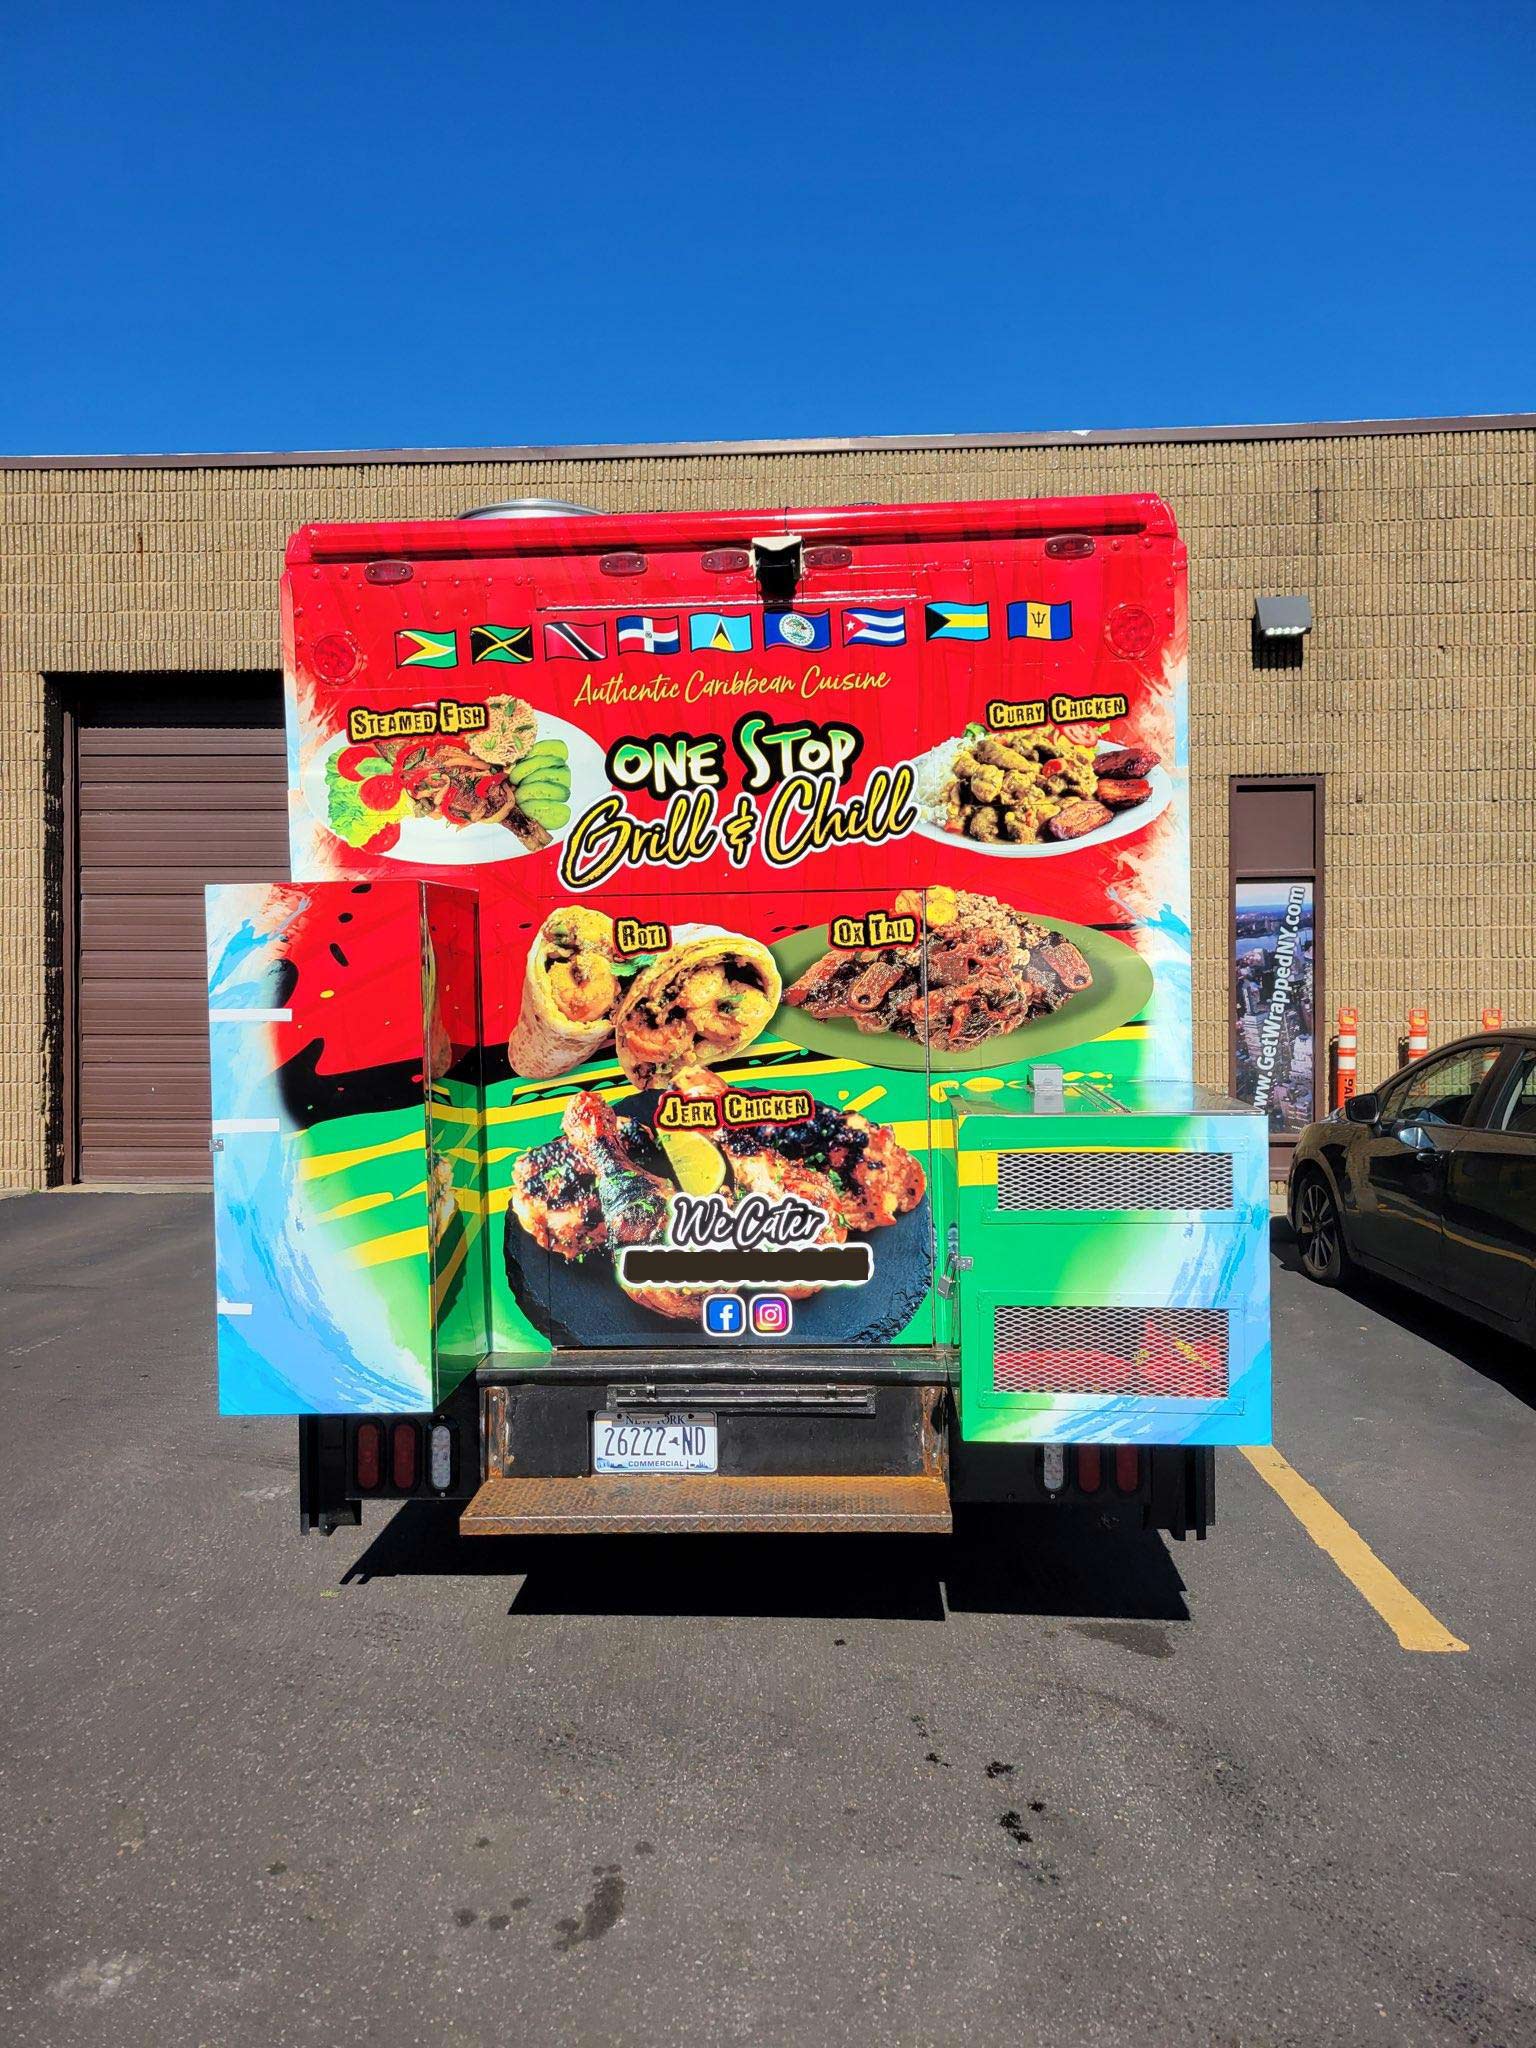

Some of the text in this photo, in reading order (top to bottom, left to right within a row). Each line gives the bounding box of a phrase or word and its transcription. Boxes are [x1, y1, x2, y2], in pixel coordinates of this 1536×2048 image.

[573, 665, 891, 707] Authentic Caribbean Cuisine
[354, 705, 482, 735] STEAMED FISH
[992, 697, 1126, 725] CURRY CHICKEN
[612, 718, 857, 793] ONE STOP
[564, 767, 916, 886] Grill & Chill
[621, 922, 665, 949] ROTI
[837, 916, 913, 945] OX TAIL
[1252, 886, 1306, 1115] ww.GetWrappedNY.com
[665, 1095, 807, 1125] JERK CHICKEN
[677, 1198, 823, 1247] We Cater
[656, 1414, 686, 1425] ORK
[604, 1427, 706, 1456] 26222 ND
